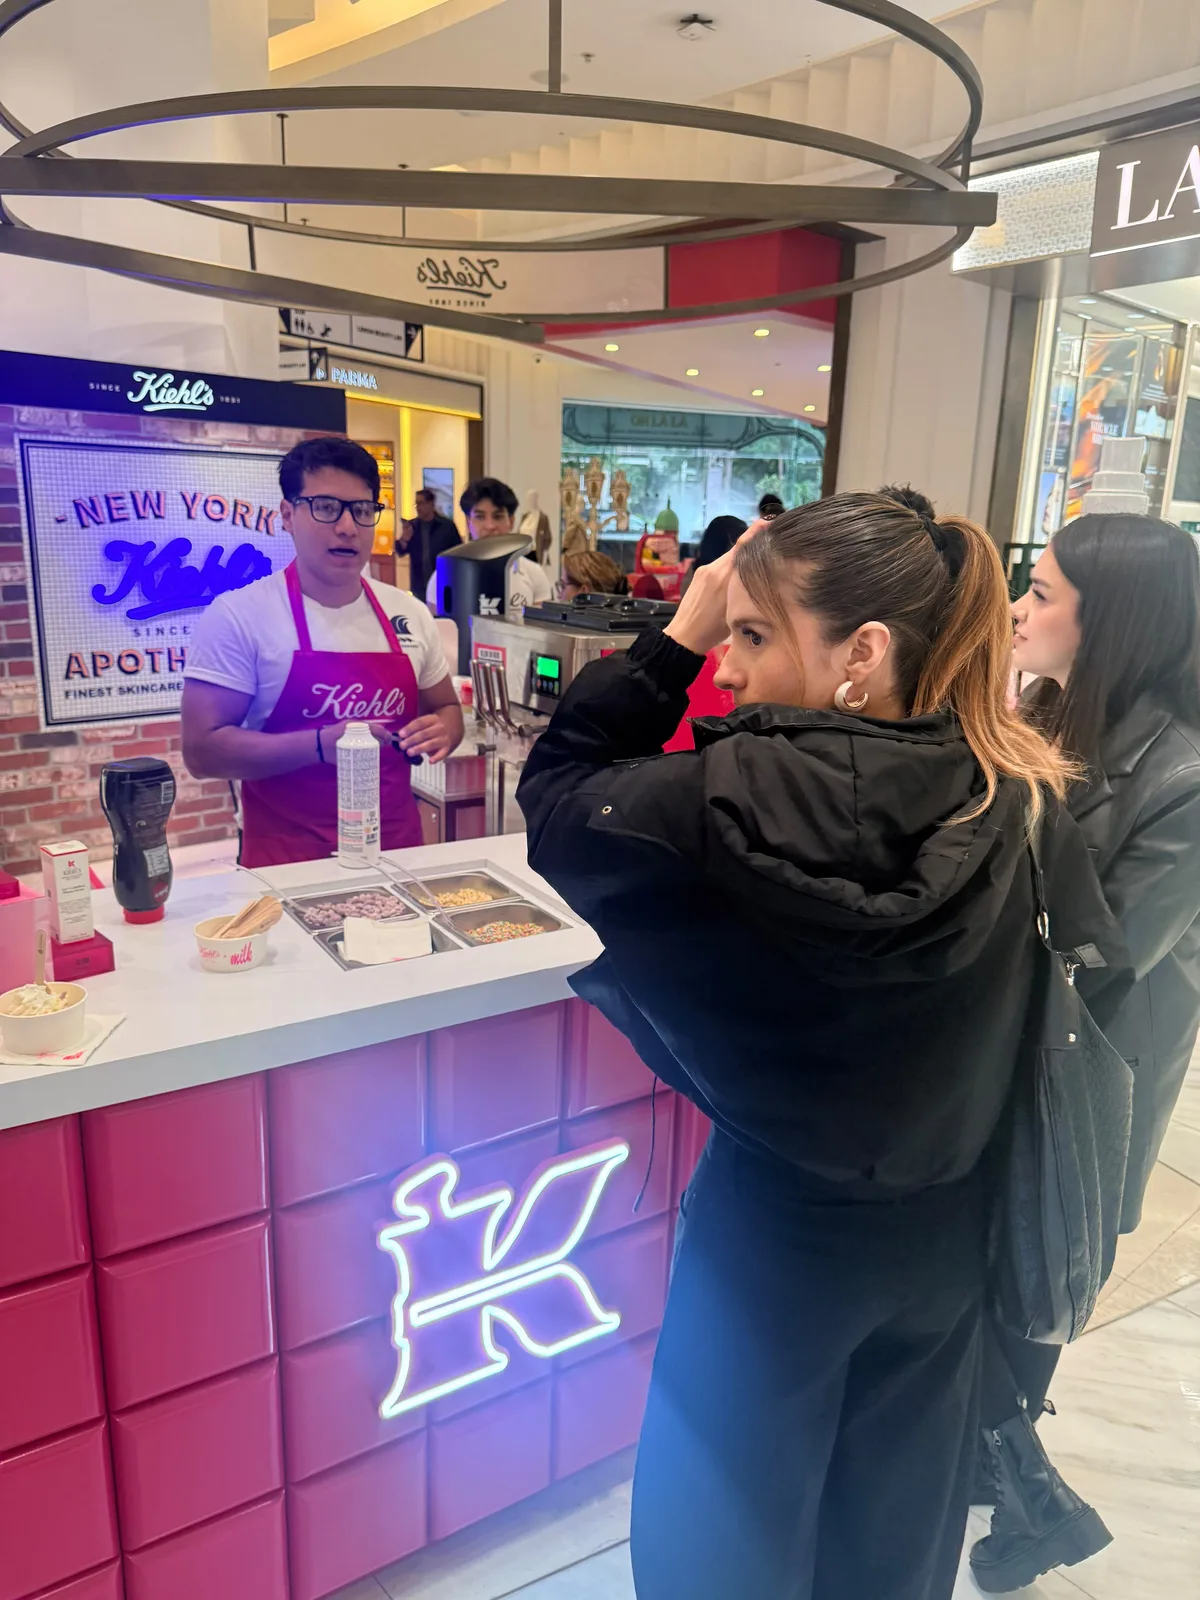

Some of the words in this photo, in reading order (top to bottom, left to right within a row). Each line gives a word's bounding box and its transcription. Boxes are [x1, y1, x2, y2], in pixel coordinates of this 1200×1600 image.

[88, 382, 121, 393] SINCE
[126, 370, 215, 406] Kiehl's
[331, 367, 378, 390] PARMA
[73, 490, 166, 529] NEW
[181, 491, 279, 536] YORK
[133, 626, 192, 637] SINCE
[65, 687, 113, 700] FINEST
[118, 682, 184, 696] SKINCARE
[302, 682, 407, 720] Kiehl's
[230, 941, 253, 966] milk
